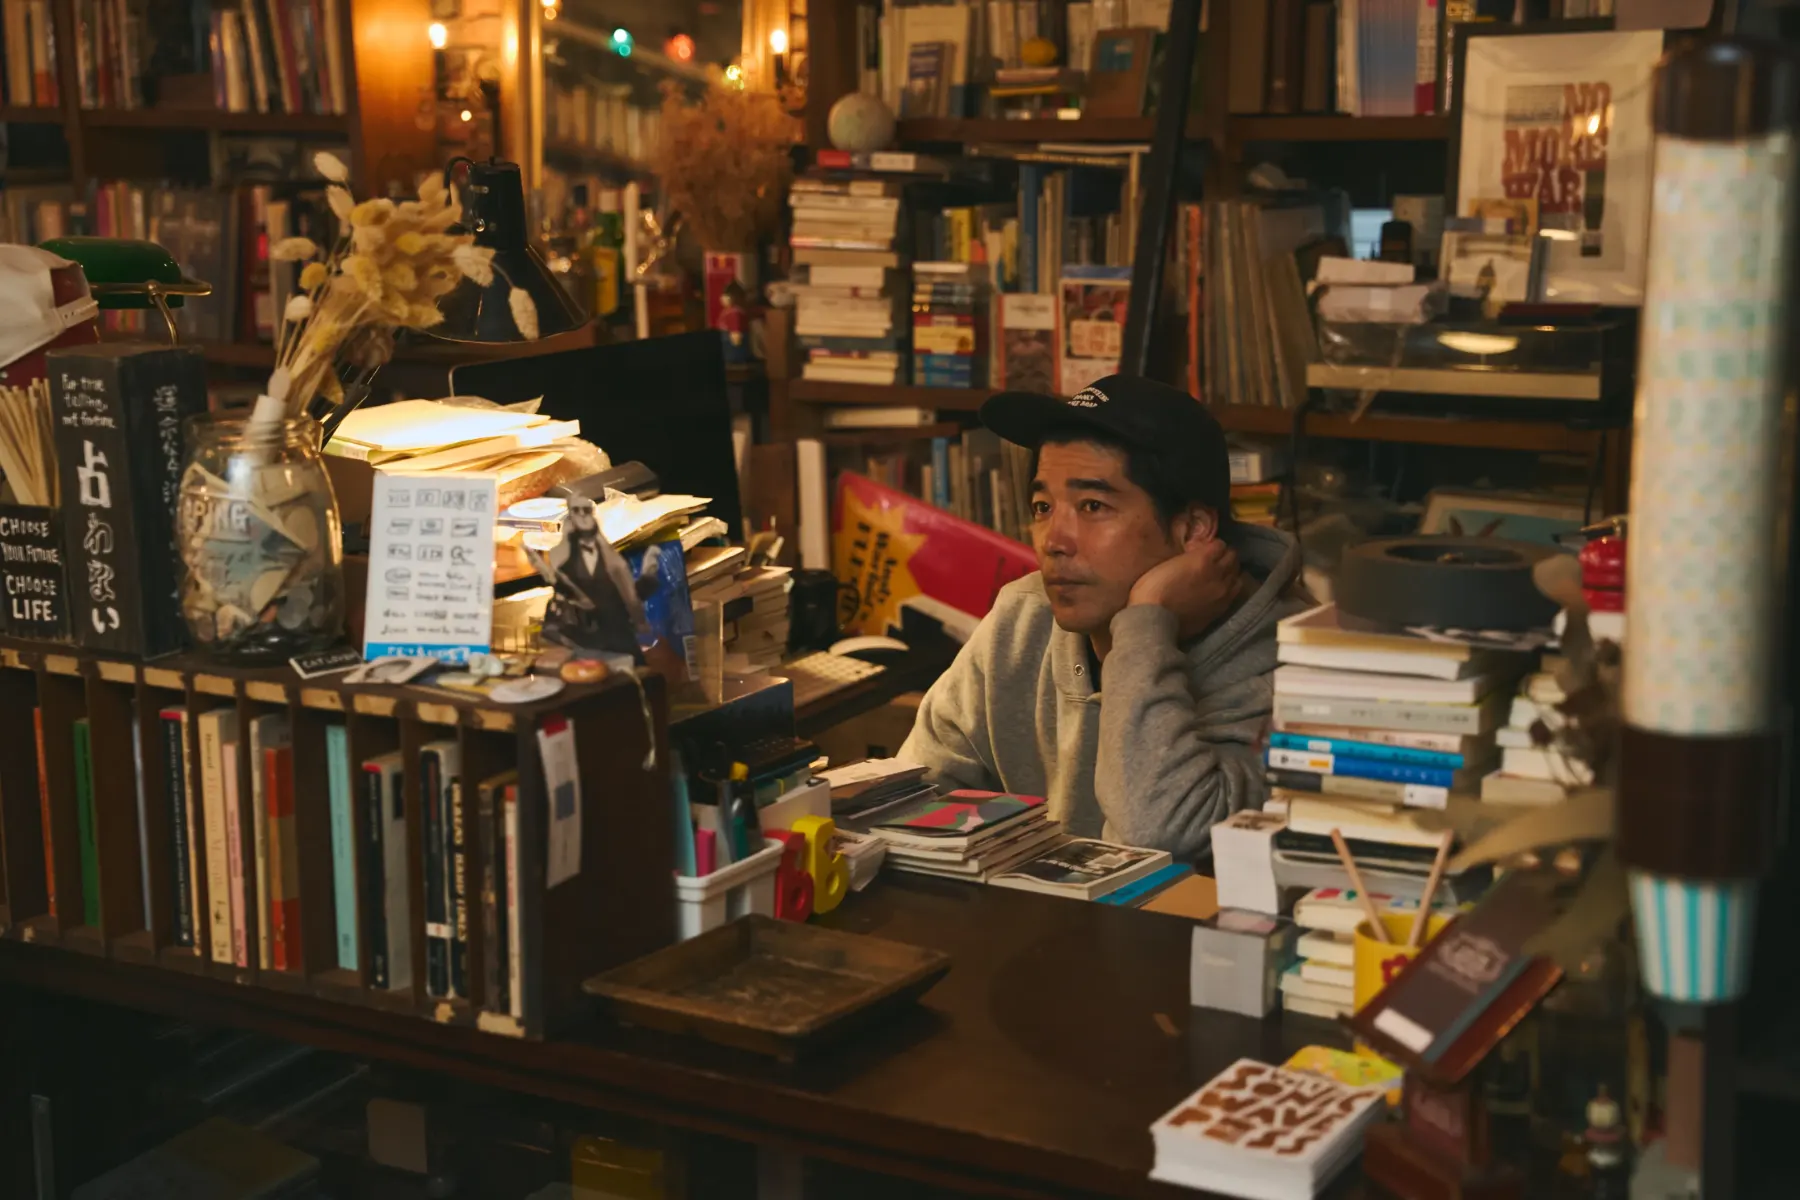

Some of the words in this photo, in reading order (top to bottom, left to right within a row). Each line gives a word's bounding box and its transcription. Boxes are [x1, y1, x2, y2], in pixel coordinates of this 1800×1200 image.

[0, 516, 49, 537] CHOOSE
[76, 439, 120, 634] 占わない
[0, 541, 25, 561] YOUR
[5, 574, 57, 595] CHOOSE
[12, 598, 58, 621] LIFE.
